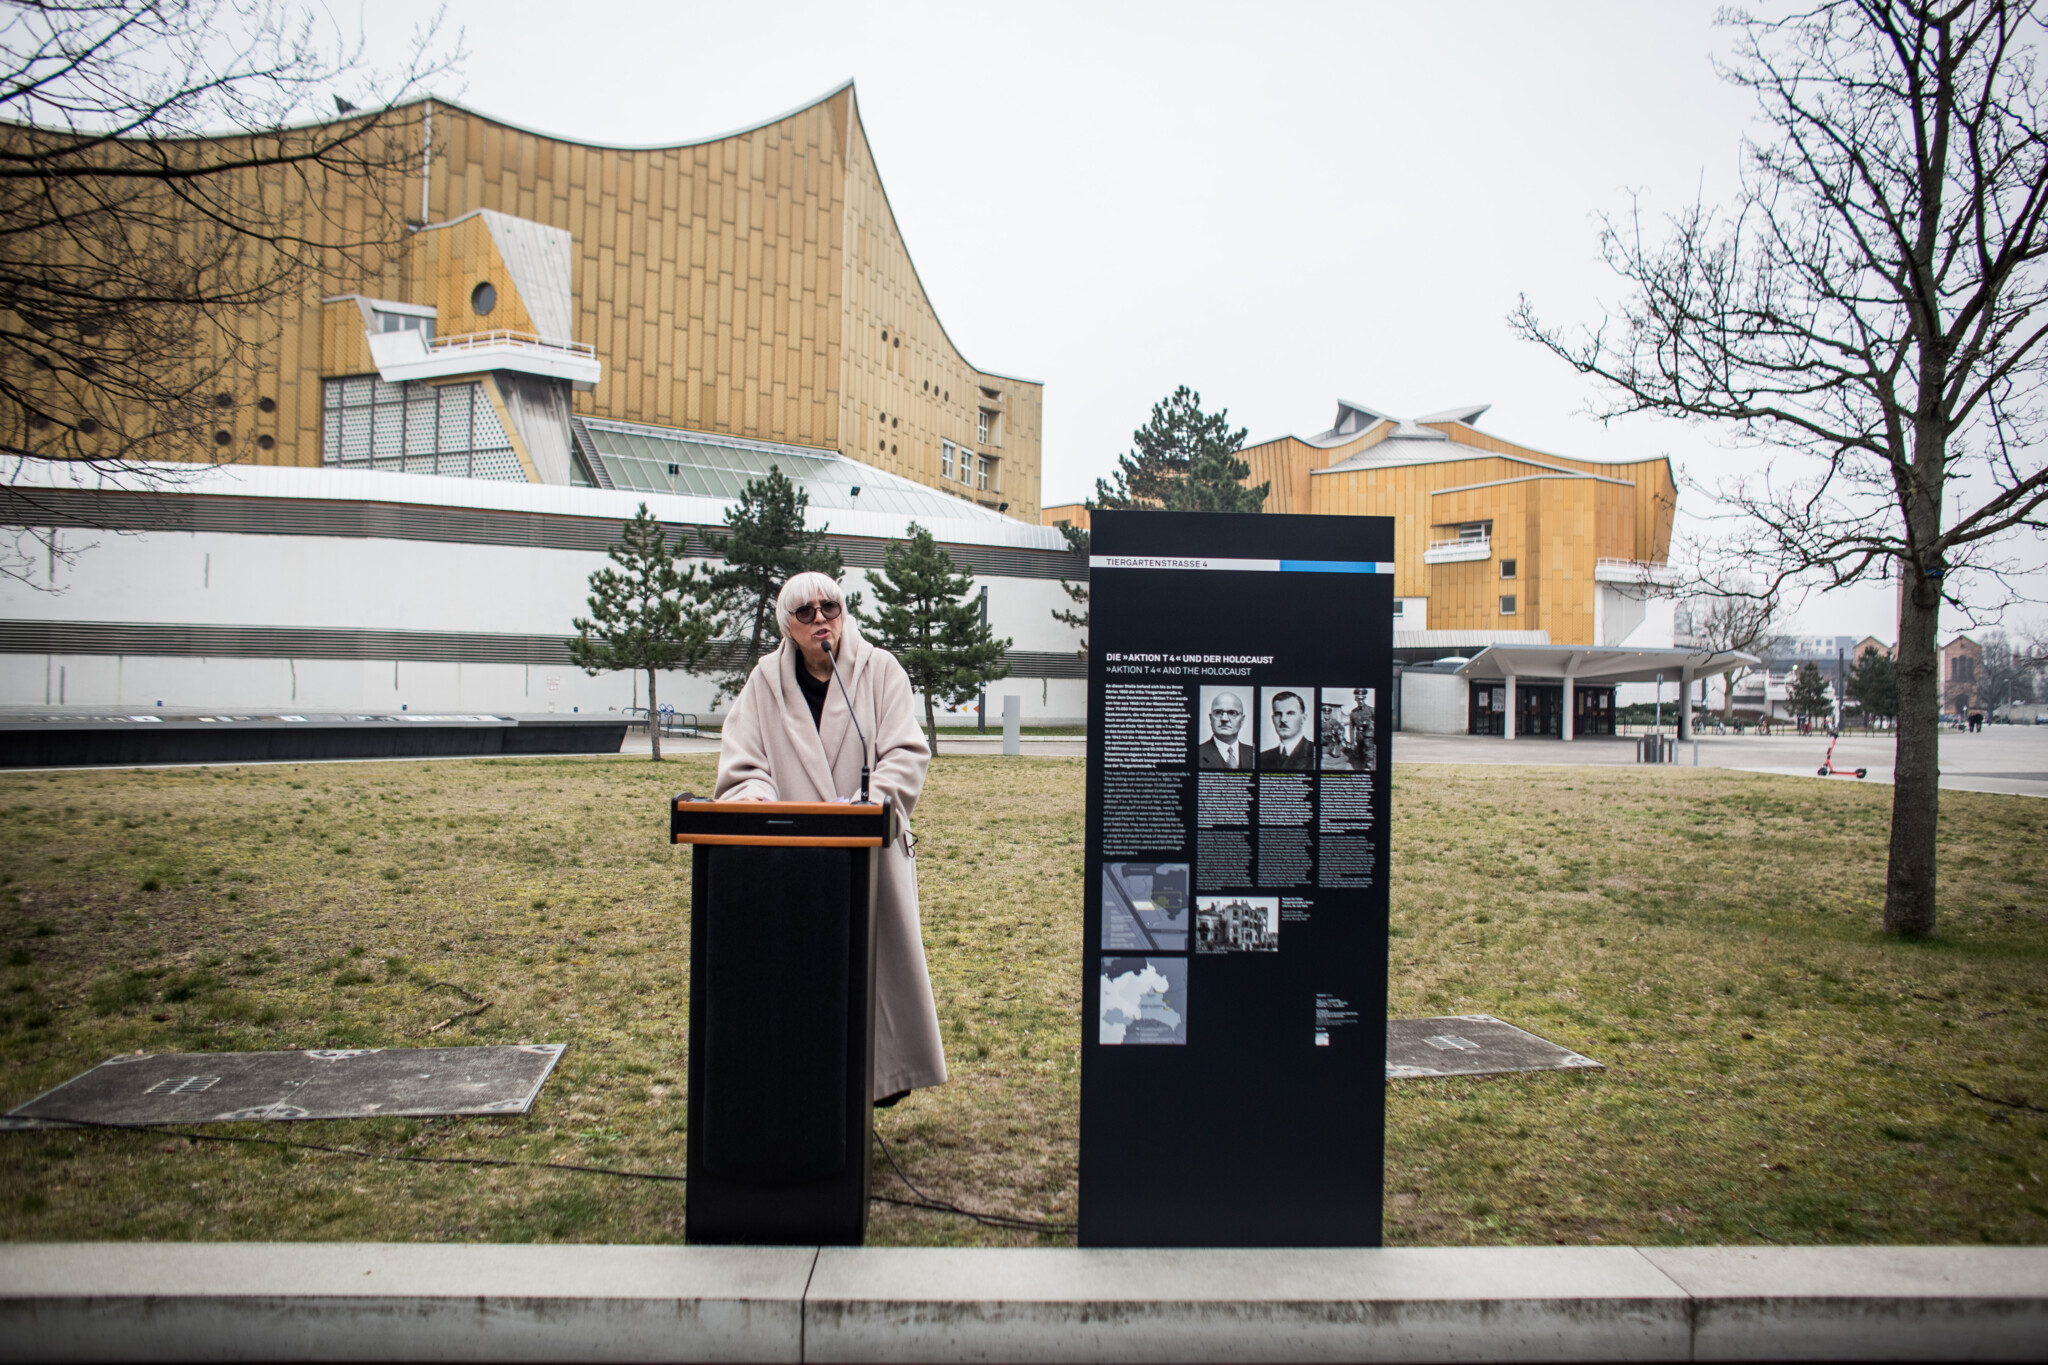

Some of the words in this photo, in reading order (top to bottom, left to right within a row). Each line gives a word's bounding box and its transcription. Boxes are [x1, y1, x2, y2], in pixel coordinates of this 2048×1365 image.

[1106, 558, 1200, 567] TIERGARTENSTRASSE
[1106, 653, 1122, 661] DIE
[1182, 654, 1202, 662] UND
[1203, 655, 1222, 663] DER
[1222, 656, 1274, 664] HOLOCAUST
[1144, 666, 1150, 674] T
[1162, 666, 1182, 674] AND
[1182, 666, 1200, 675] THE
[1202, 667, 1252, 676] HOLOCAUST
